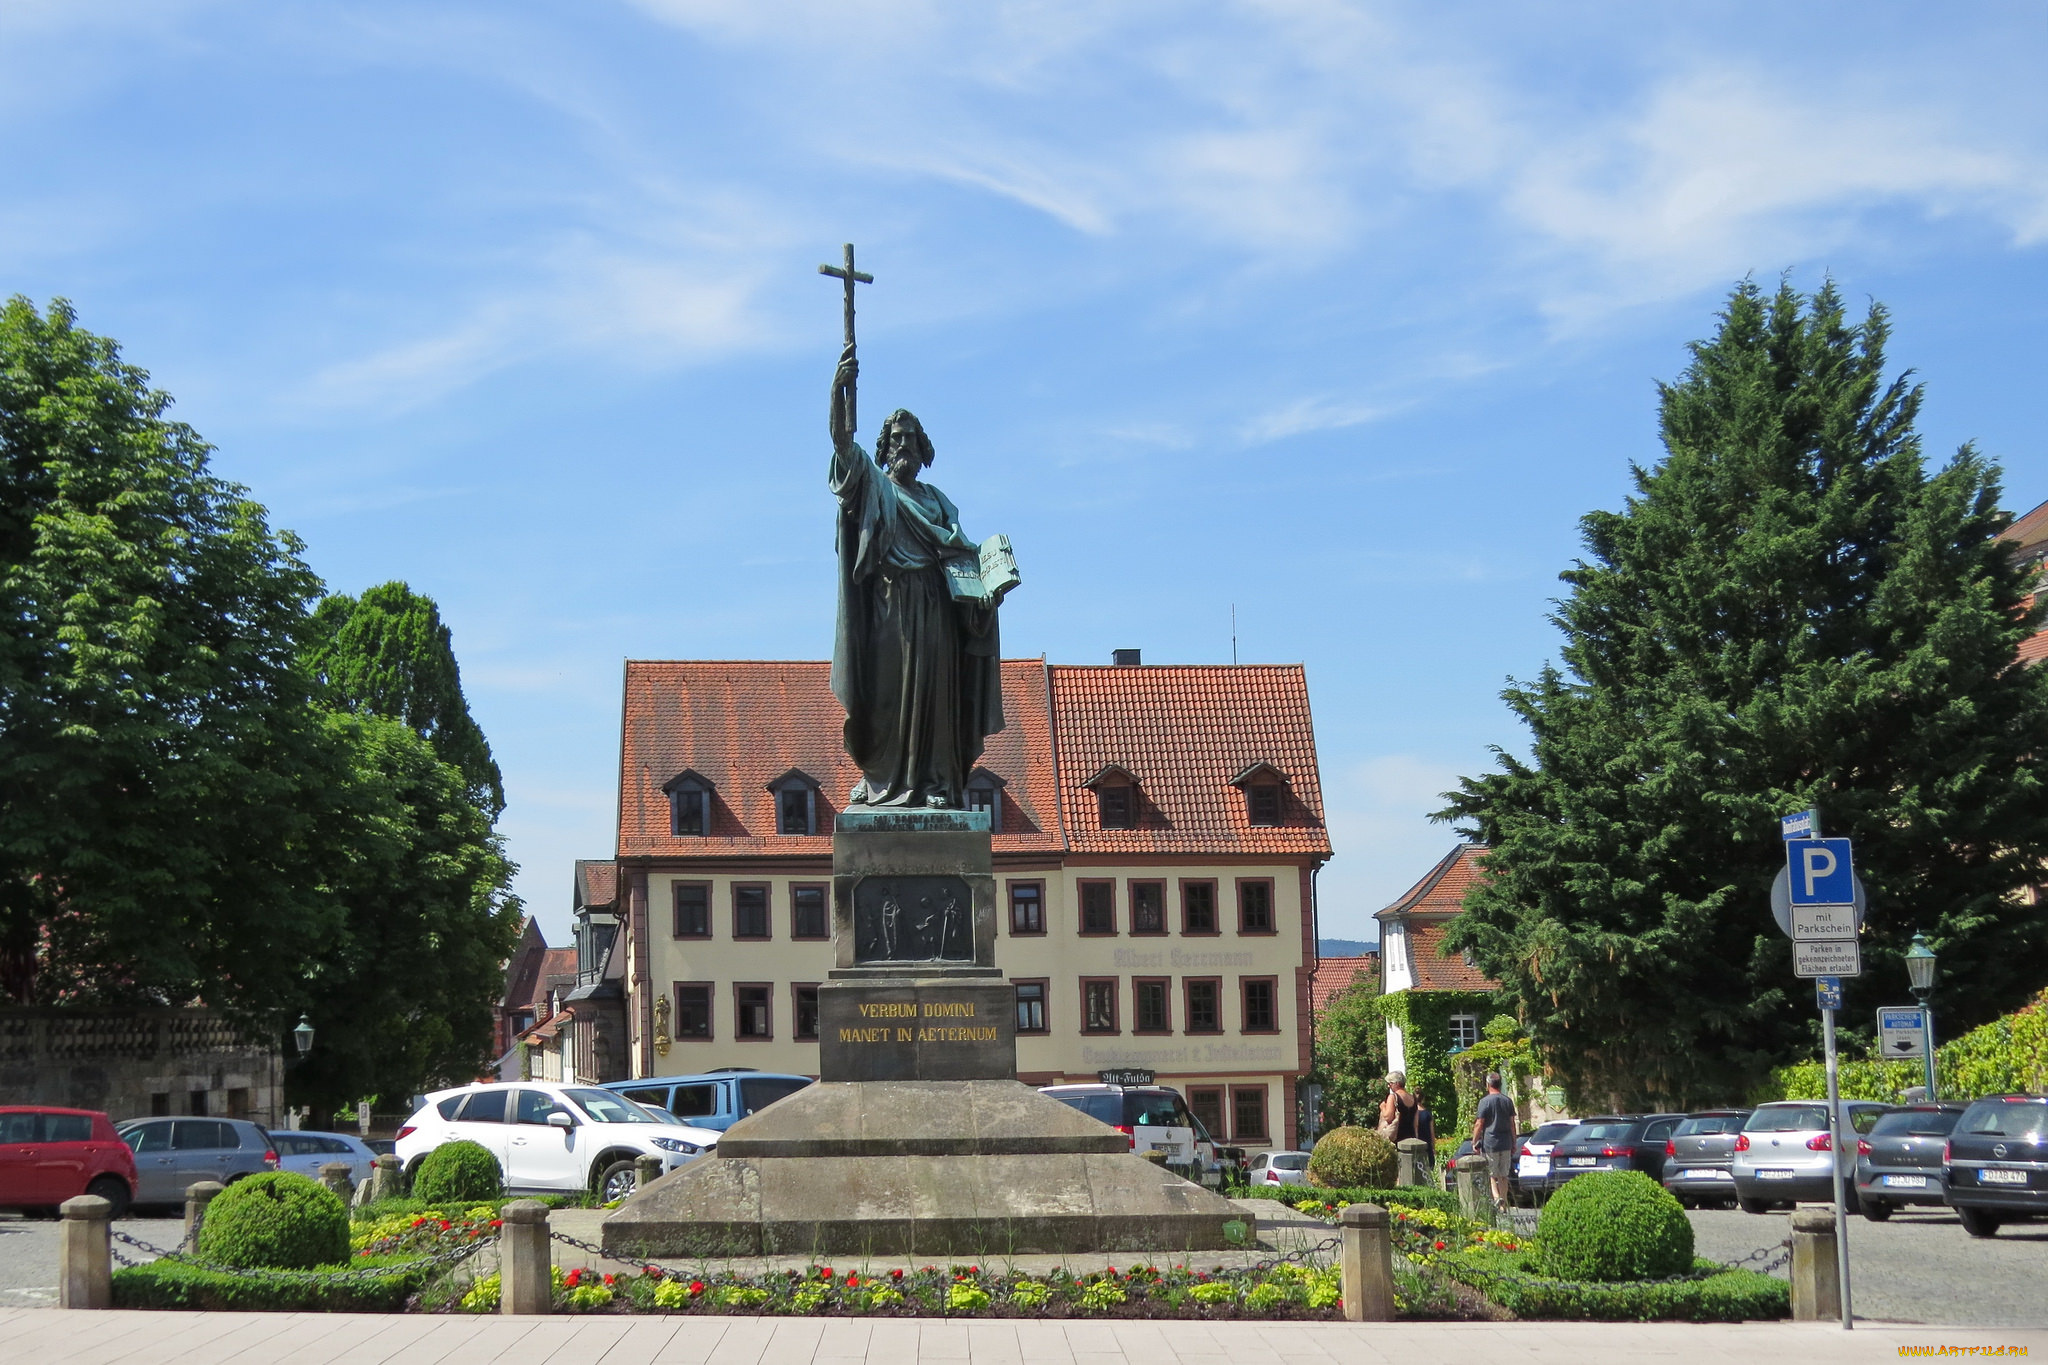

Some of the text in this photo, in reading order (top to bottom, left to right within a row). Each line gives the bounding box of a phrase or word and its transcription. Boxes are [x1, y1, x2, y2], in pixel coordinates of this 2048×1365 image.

[1803, 847, 1837, 896] P
[1816, 912, 1832, 921] mit
[1797, 923, 1852, 933] Parkschein
[1810, 944, 1842, 953] Parken in
[858, 1002, 975, 1018] VERBUM DOMINI
[839, 1027, 997, 1042] MANET IN AETERNUM
